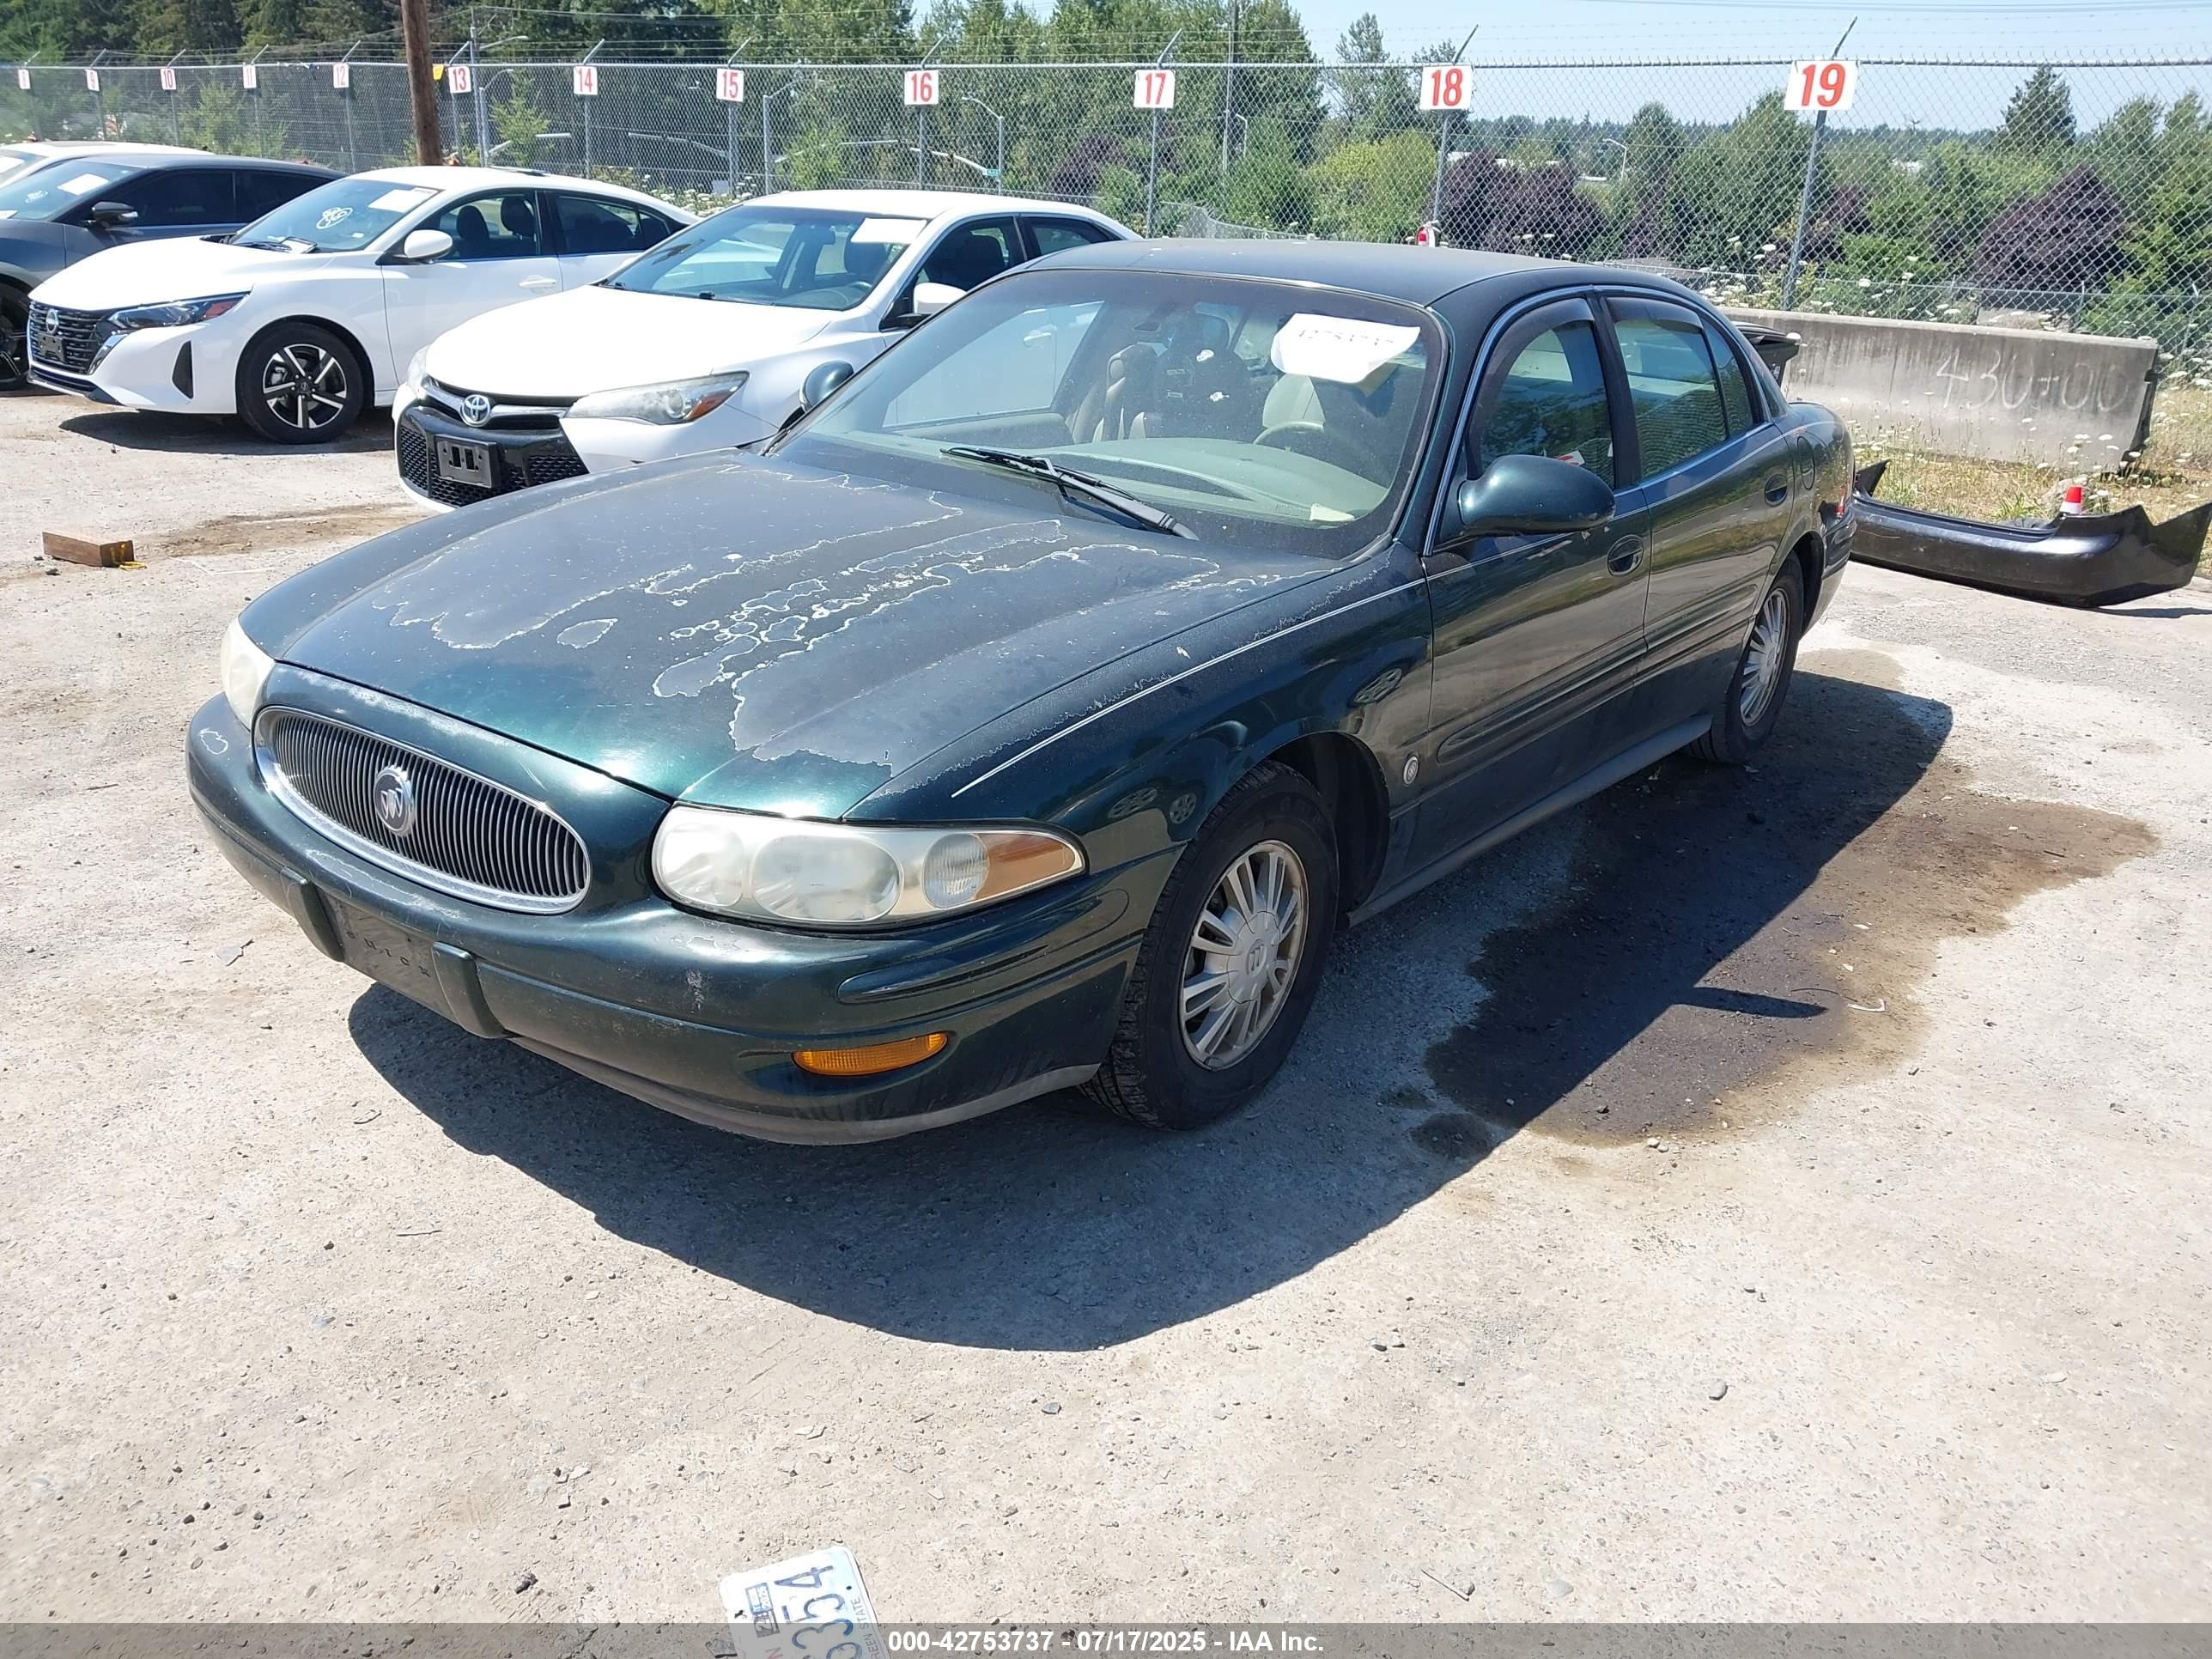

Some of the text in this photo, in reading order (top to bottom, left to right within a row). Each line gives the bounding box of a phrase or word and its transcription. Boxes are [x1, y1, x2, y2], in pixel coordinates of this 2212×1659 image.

[163, 69, 173, 88] 10
[246, 68, 254, 86] 11
[335, 66, 346, 87] 12
[452, 67, 467, 91] 13
[578, 68, 592, 92] 14
[722, 70, 738, 99] 15
[910, 72, 933, 102] 16
[1145, 72, 1167, 105] 17
[1431, 68, 1463, 106] 18
[1801, 63, 1846, 107] 19
[850, 1596, 870, 1630] STATE
